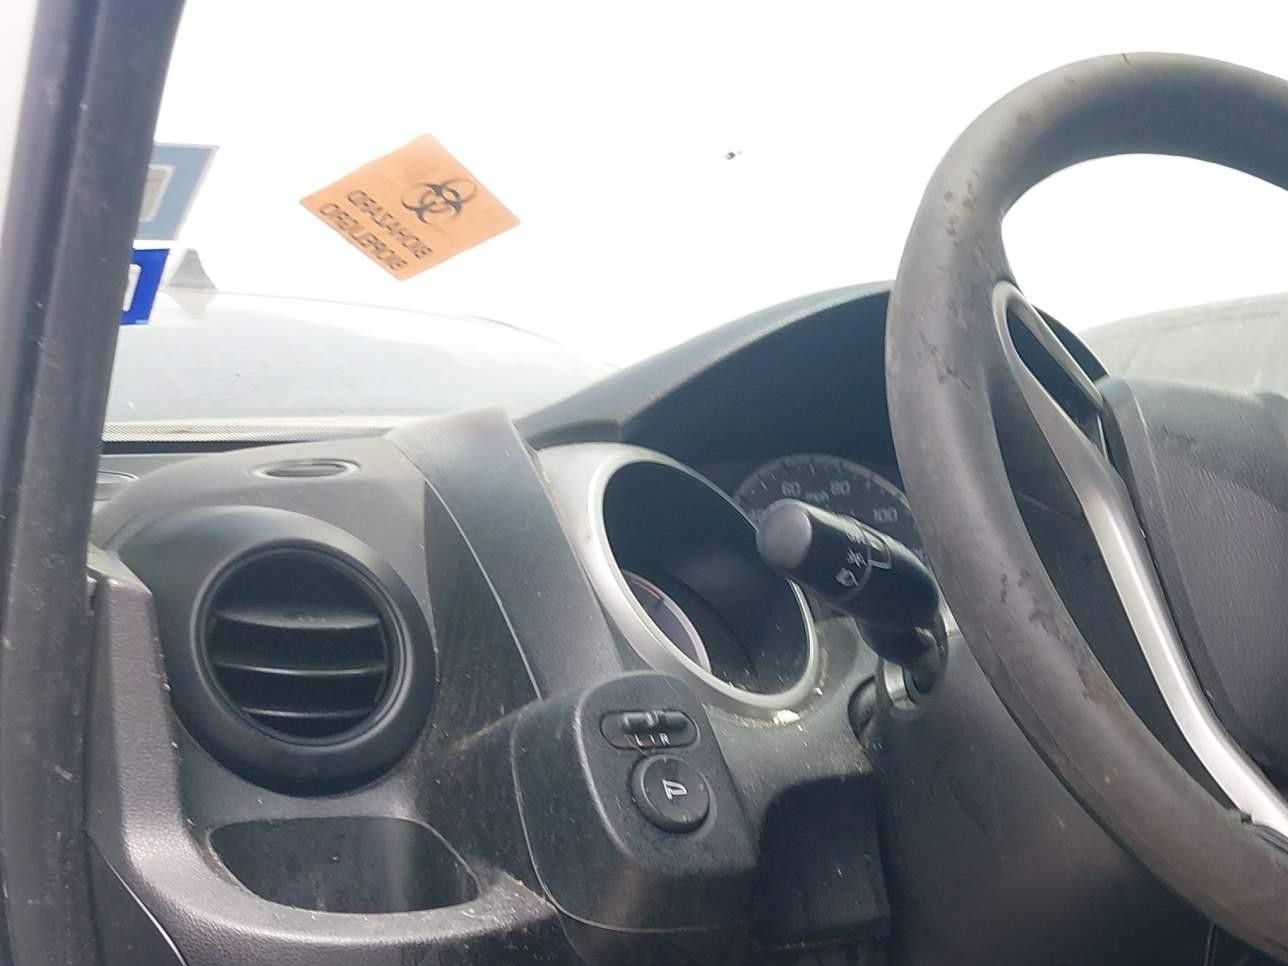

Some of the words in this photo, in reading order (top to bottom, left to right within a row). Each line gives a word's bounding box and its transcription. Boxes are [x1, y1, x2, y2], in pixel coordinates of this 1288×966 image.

[781, 481, 801, 498] 60
[830, 481, 851, 496] 80
[873, 507, 898, 524] 100
[660, 733, 670, 745] R
